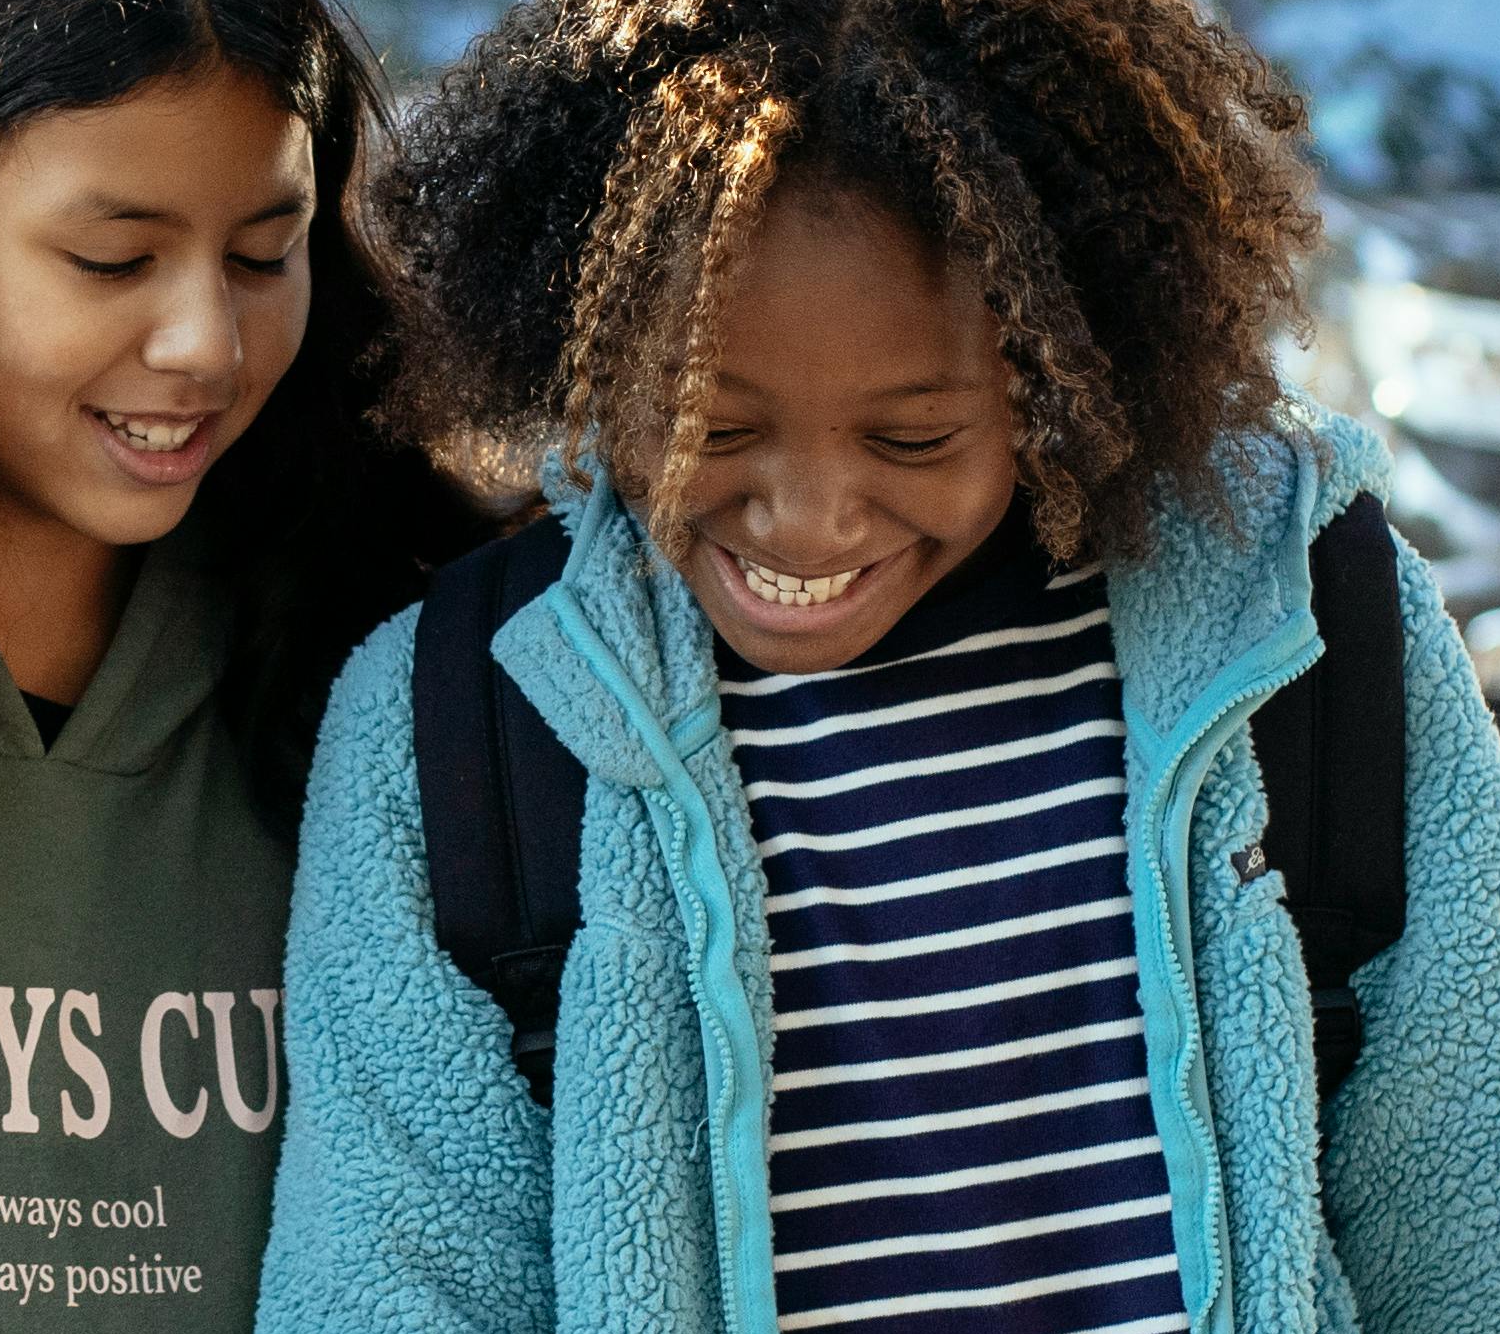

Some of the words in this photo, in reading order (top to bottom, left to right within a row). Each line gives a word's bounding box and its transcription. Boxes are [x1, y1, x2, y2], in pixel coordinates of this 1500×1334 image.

[140, 988, 287, 1139] CU
[91, 1185, 168, 1229] cool
[64, 1252, 204, 1308] positive
